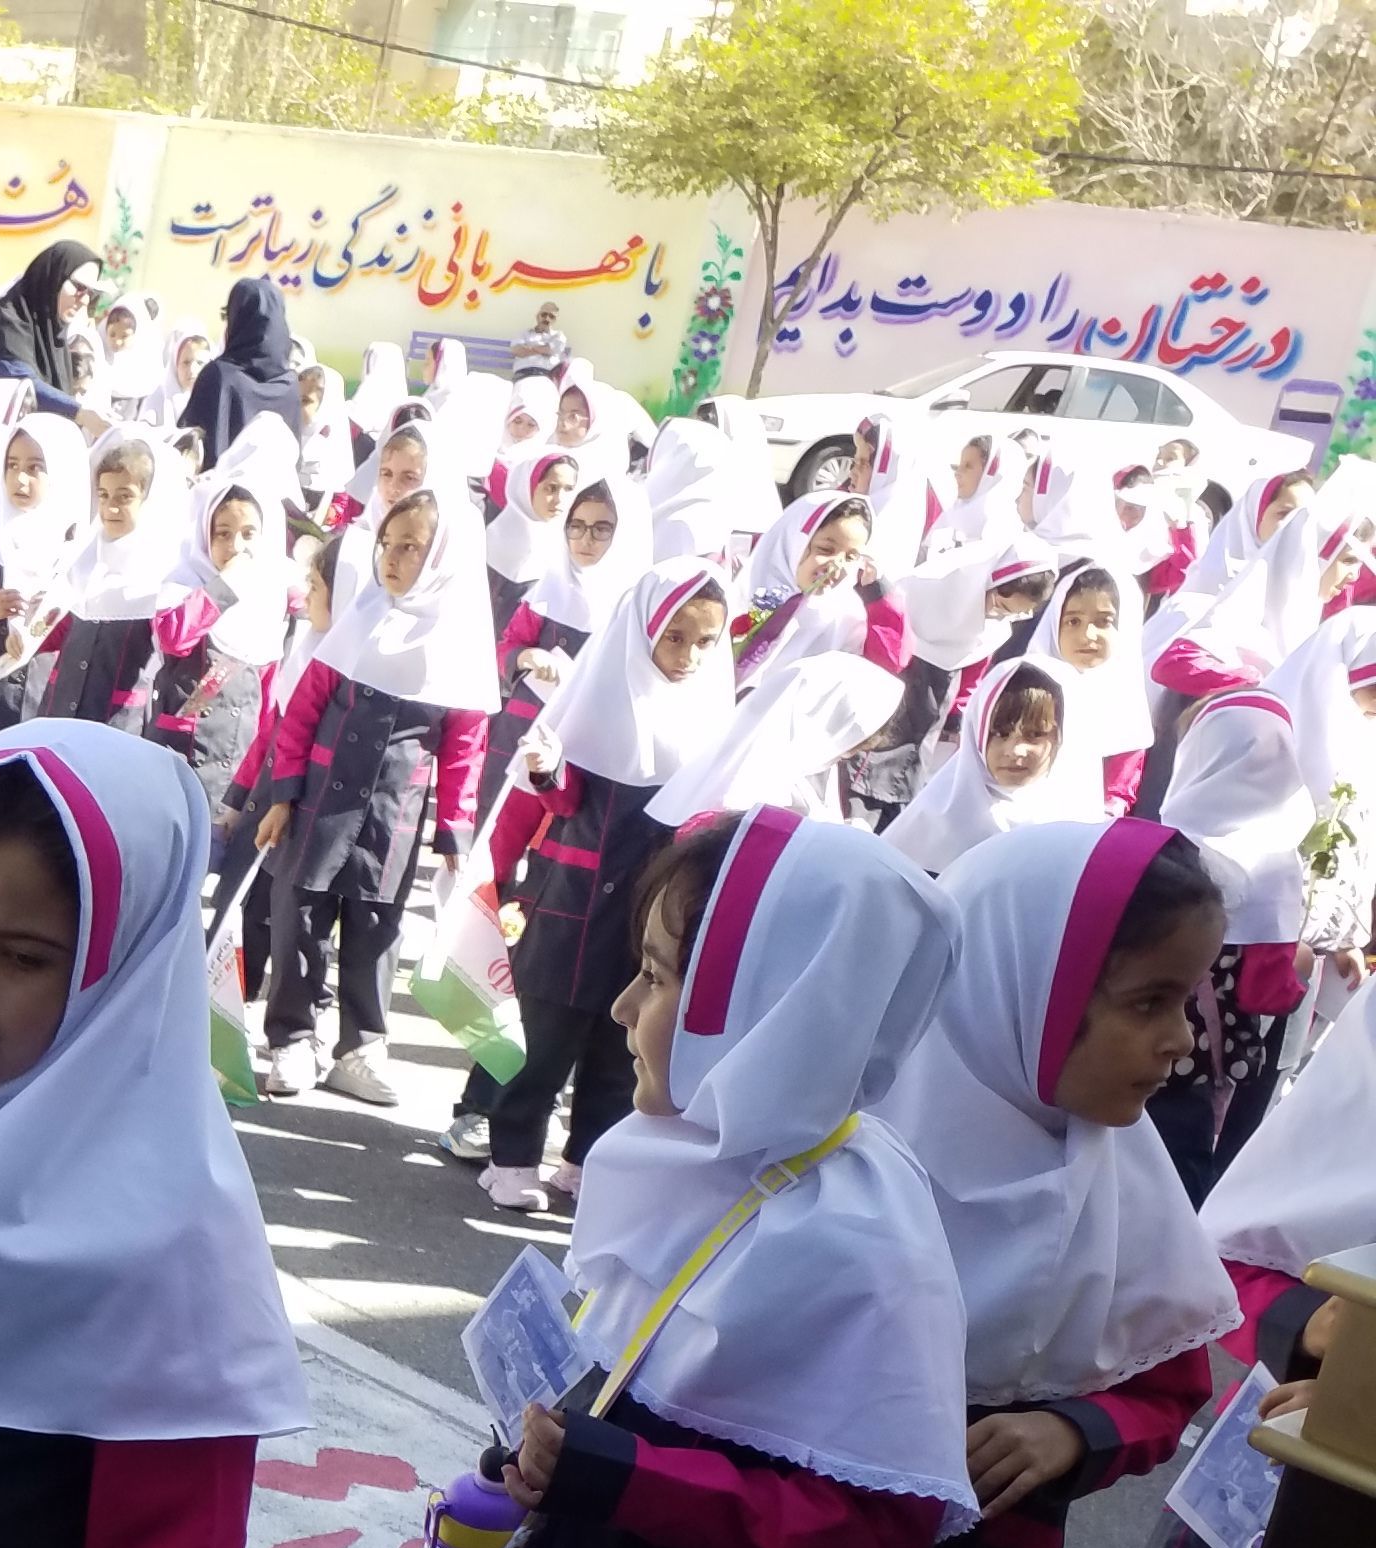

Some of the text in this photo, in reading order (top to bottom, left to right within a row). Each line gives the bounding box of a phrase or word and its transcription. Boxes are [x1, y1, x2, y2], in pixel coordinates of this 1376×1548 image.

[168, 202, 249, 266] است
[311, 184, 436, 294] زندگی
[635, 241, 670, 339] با
[869, 273, 1036, 342] دوست
[1040, 271, 1087, 348] را
[1073, 272, 1303, 382] درختان
